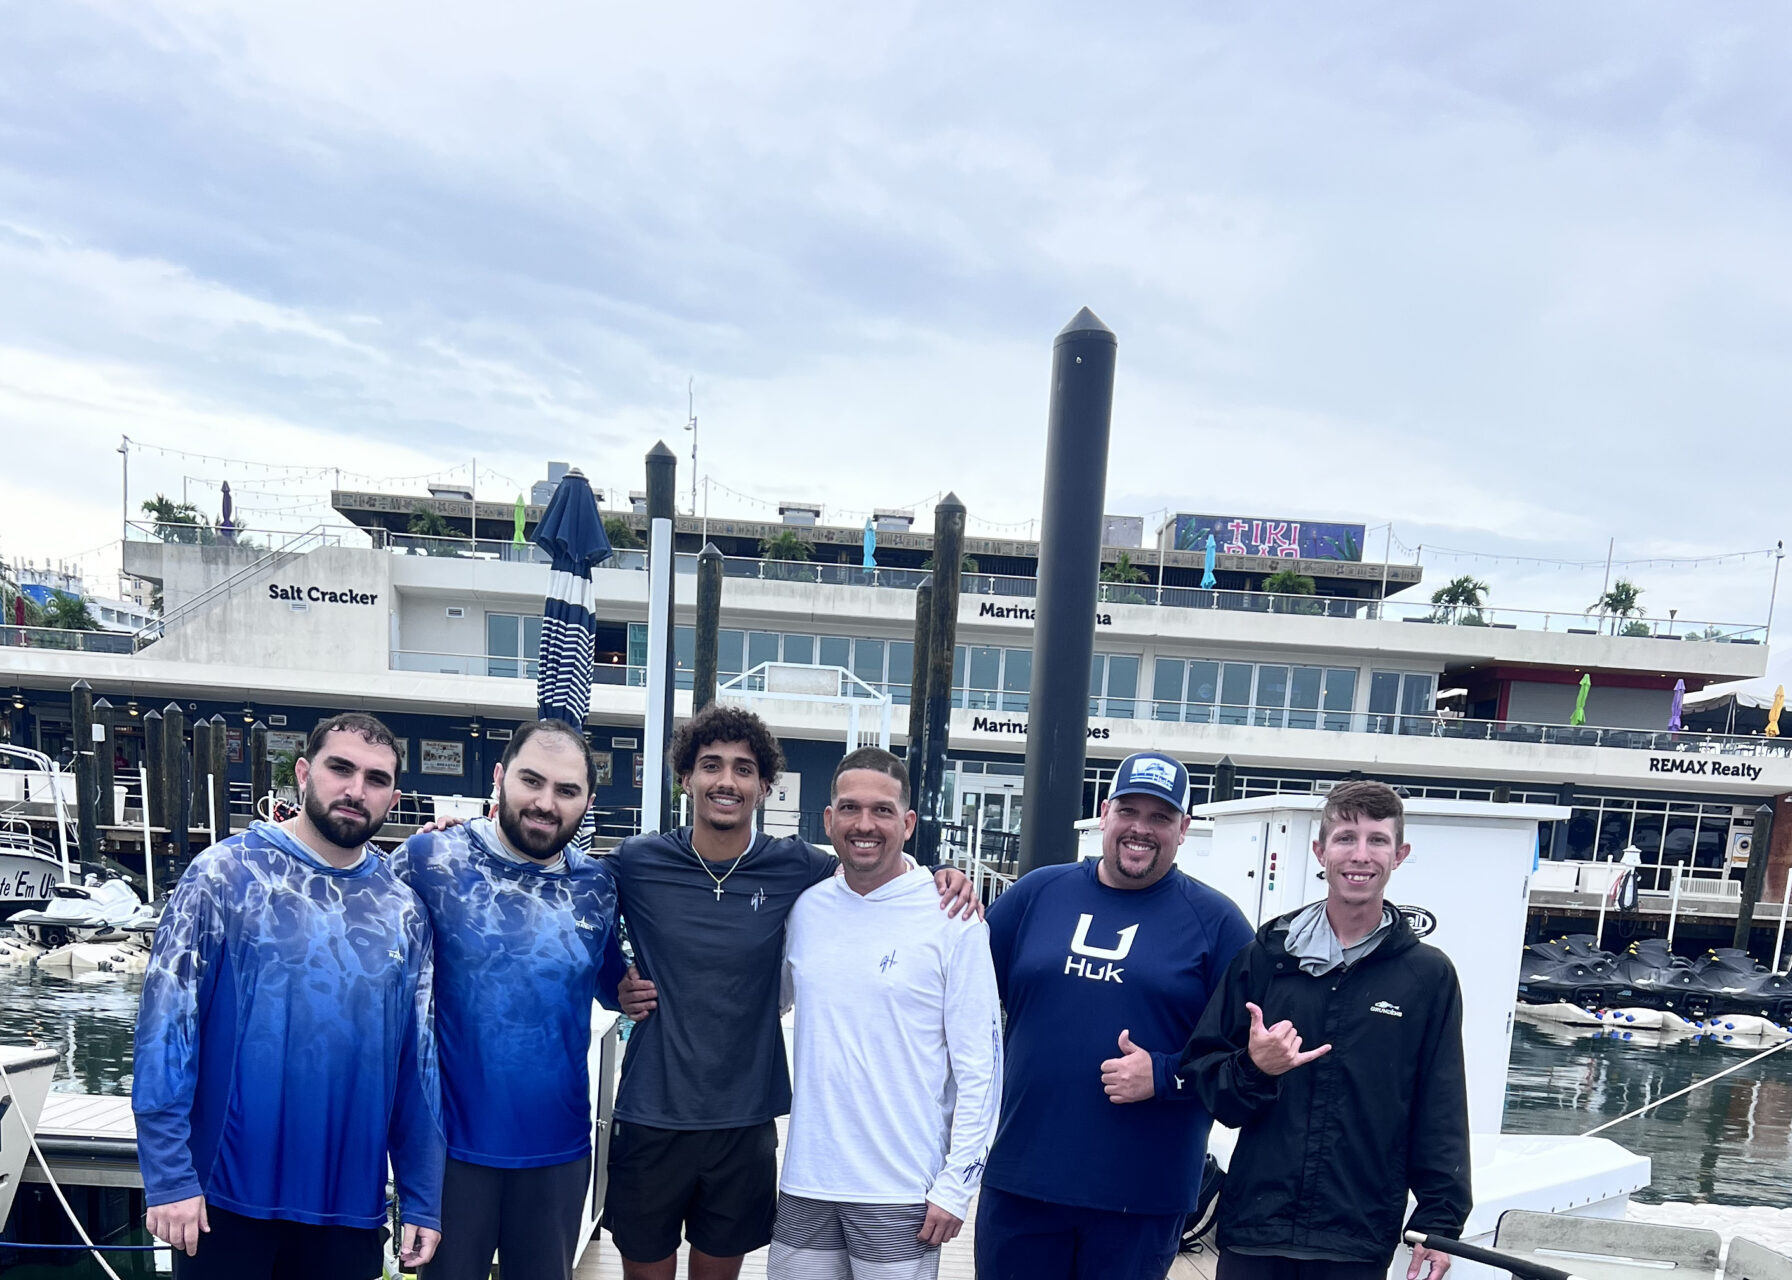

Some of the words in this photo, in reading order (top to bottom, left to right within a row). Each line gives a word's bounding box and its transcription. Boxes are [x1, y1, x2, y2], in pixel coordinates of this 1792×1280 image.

[1227, 519, 1300, 547] TIKI
[269, 584, 303, 601] Salt
[307, 586, 378, 605] Cracker
[1649, 757, 1708, 775] REMAX
[1711, 761, 1762, 781] Realty
